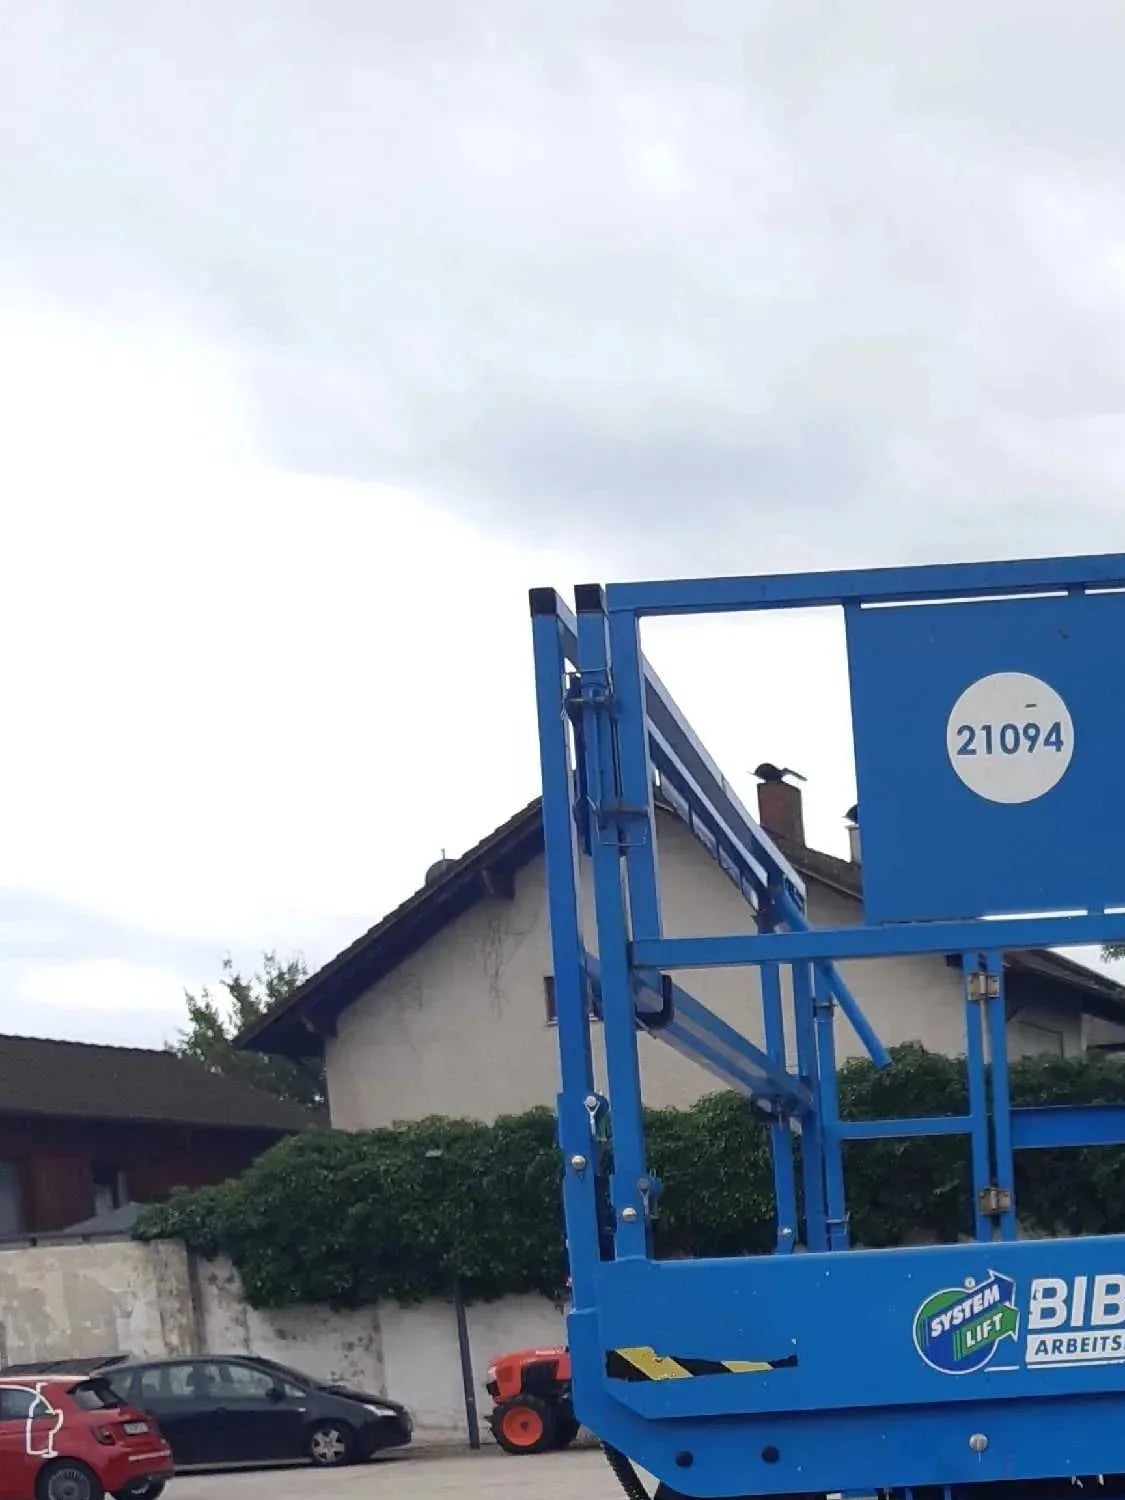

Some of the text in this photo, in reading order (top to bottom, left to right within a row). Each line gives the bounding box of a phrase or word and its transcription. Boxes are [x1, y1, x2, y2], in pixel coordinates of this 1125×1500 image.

[957, 721, 1064, 755] 21094
[930, 1284, 1001, 1338] SYSTEM
[966, 1312, 1004, 1348] LIFT
